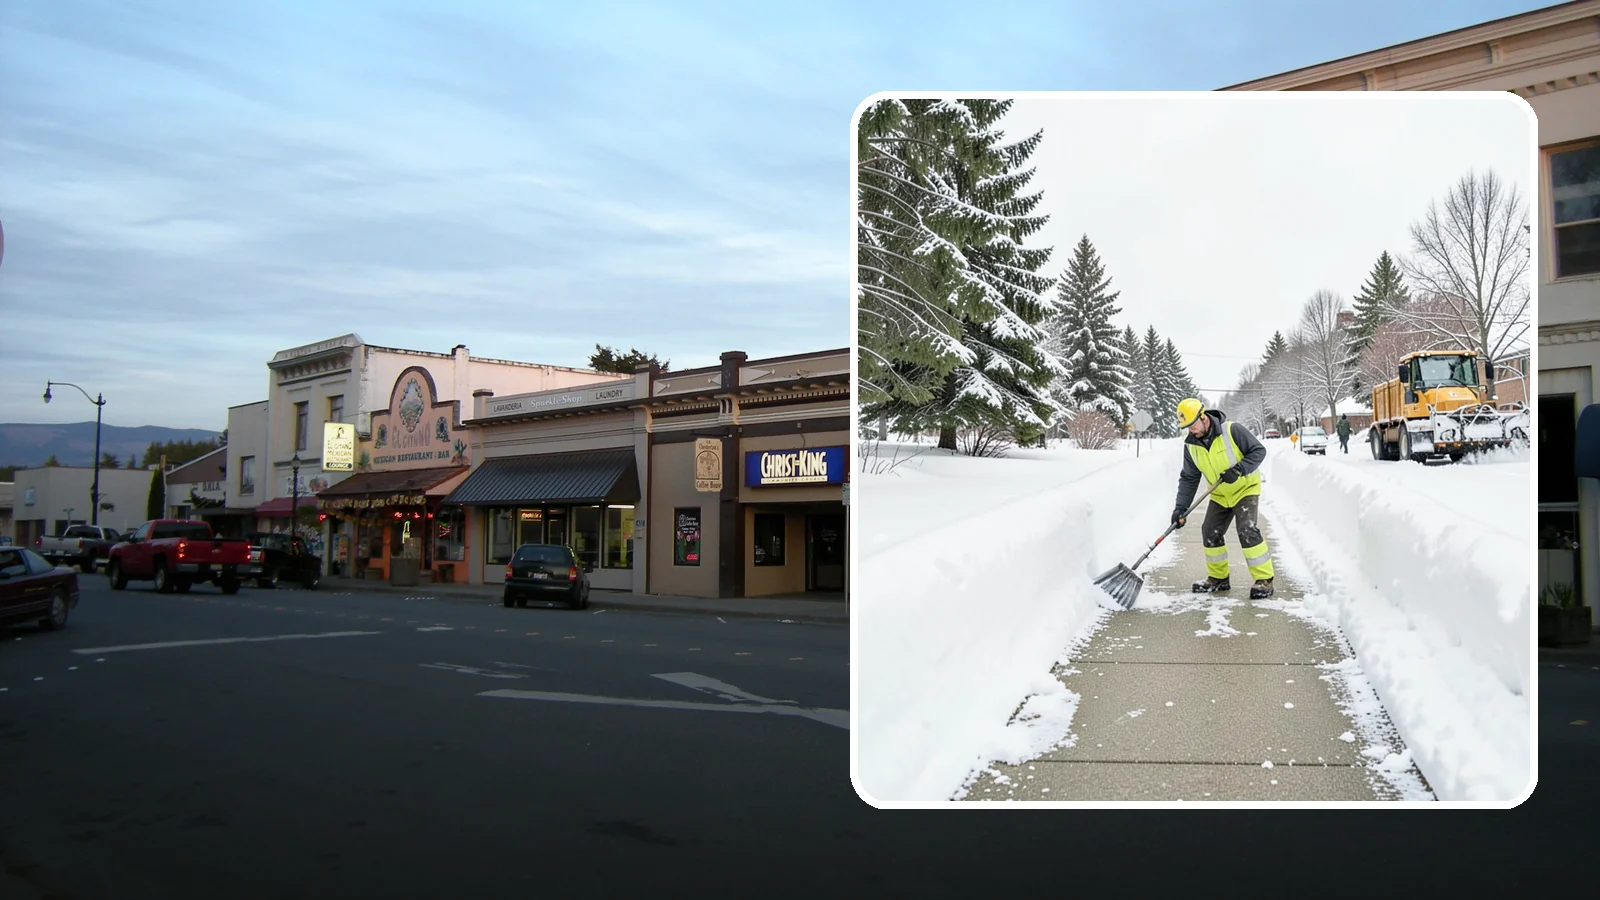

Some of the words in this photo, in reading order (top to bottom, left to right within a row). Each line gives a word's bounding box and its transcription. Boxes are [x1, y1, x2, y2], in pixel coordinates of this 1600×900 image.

[493, 402, 523, 413] LAVANDERIA
[561, 394, 583, 403] Shop
[595, 389, 623, 400] LAUNDRY
[397, 451, 433, 462] RESTAURANT
[438, 450, 450, 458] BAR
[761, 452, 797, 478] CHRIST
[799, 450, 827, 476] KING
